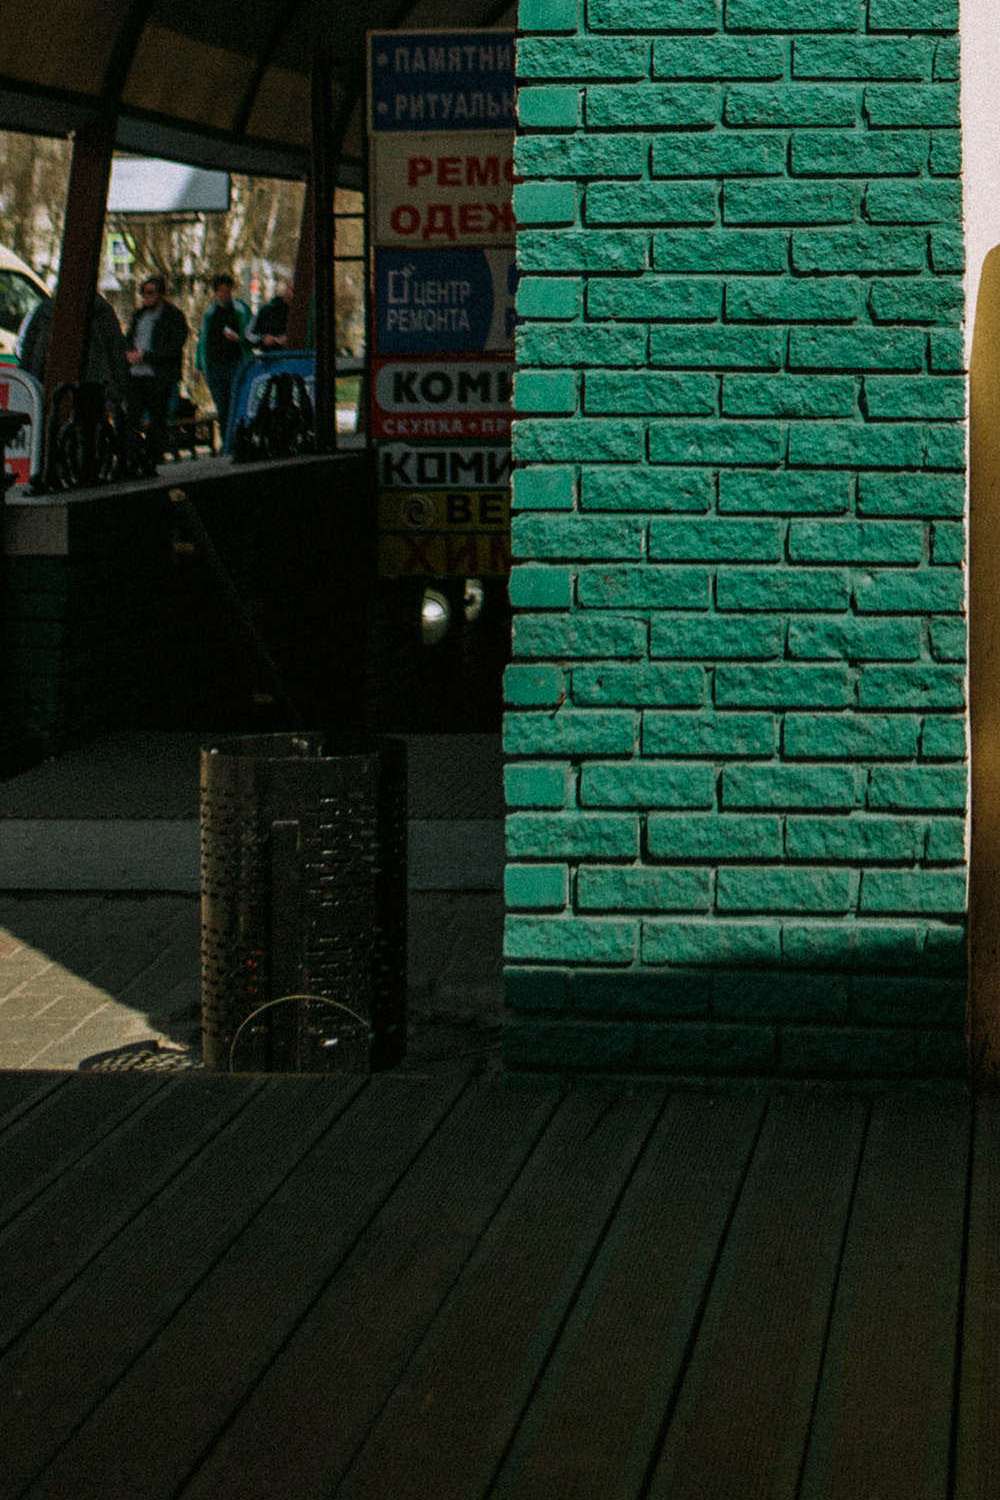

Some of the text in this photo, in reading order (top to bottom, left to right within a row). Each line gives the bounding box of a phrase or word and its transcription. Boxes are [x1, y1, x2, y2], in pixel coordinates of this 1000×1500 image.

[412, 280, 471, 307] ЦЕНТР
[386, 307, 471, 332] РЕМОНТА
[381, 417, 465, 435] СКУПКА
